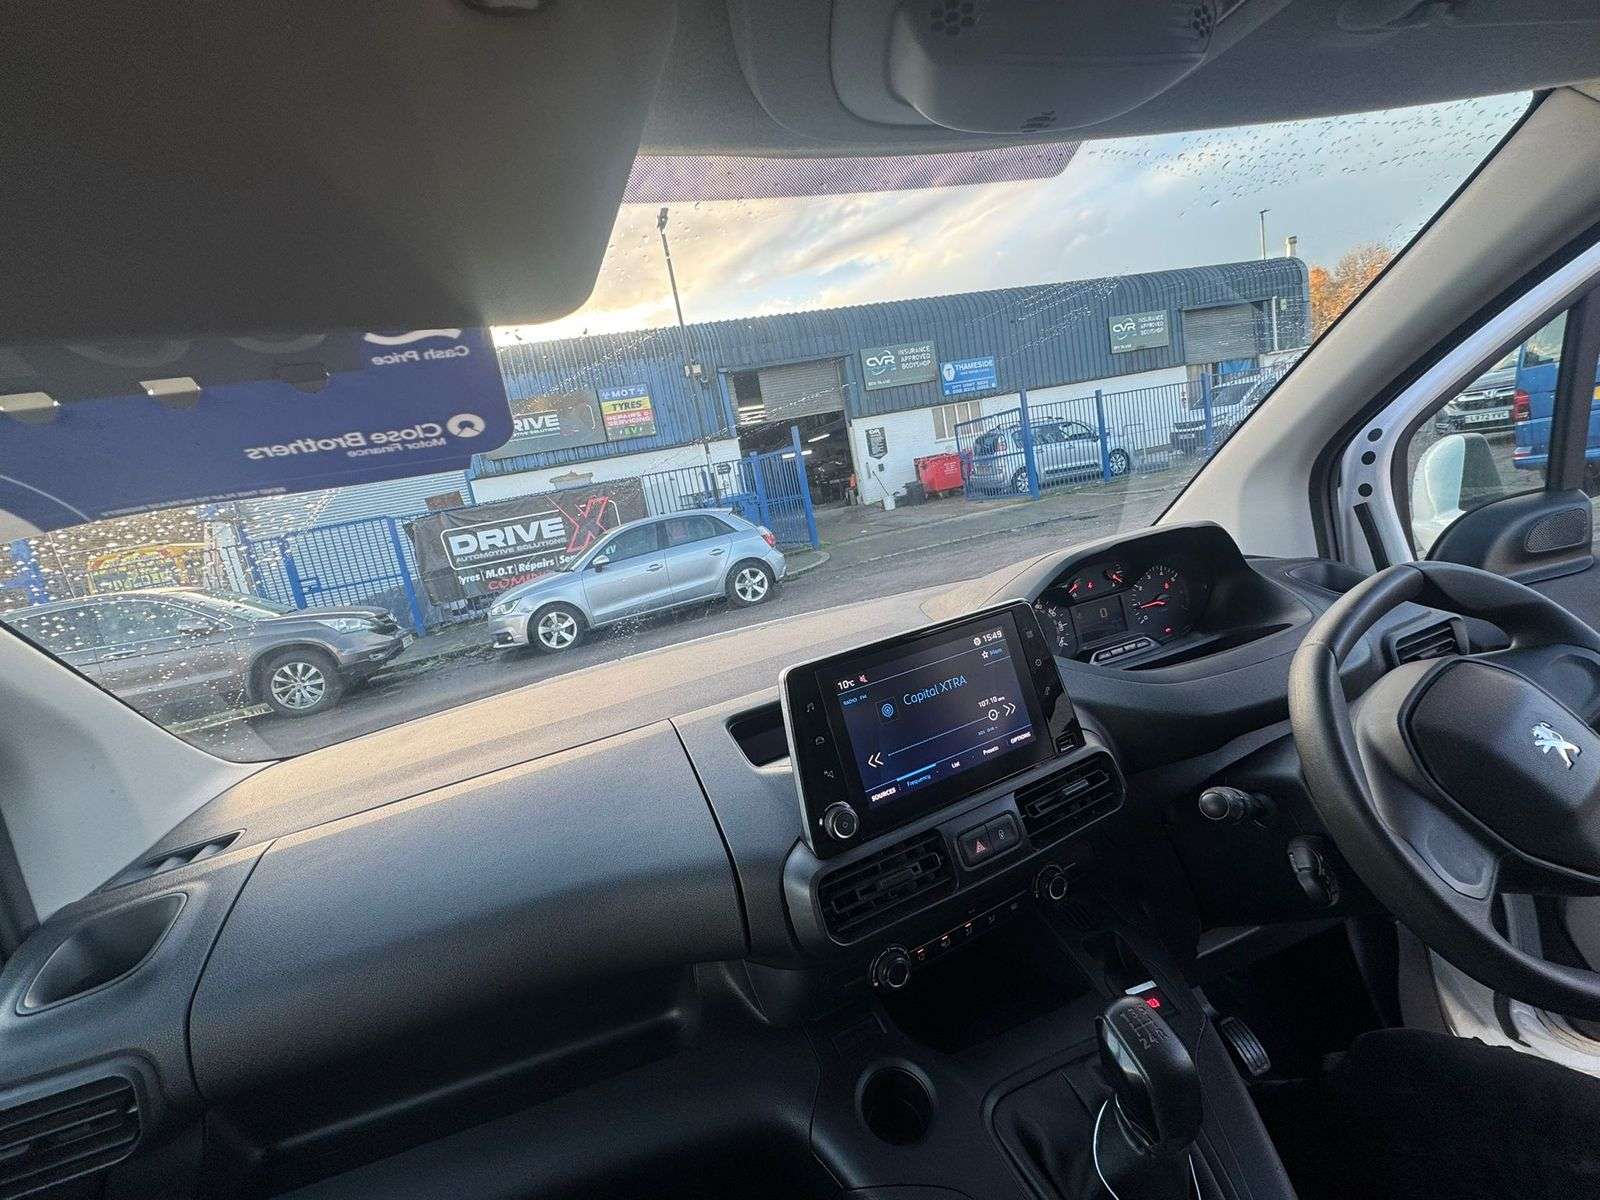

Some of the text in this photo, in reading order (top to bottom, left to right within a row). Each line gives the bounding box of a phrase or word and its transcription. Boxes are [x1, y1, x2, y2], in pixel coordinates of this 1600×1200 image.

[866, 355, 895, 367] CVR
[611, 388, 635, 398] MOT
[612, 400, 642, 411] TYRES
[448, 517, 566, 556] DRIVE
[456, 537, 566, 563] AUTOMOTIVE SOLUTIONS
[458, 573, 481, 585] Tyres
[903, 674, 968, 706] Capital XTRA
[871, 787, 897, 802] SOURCES
